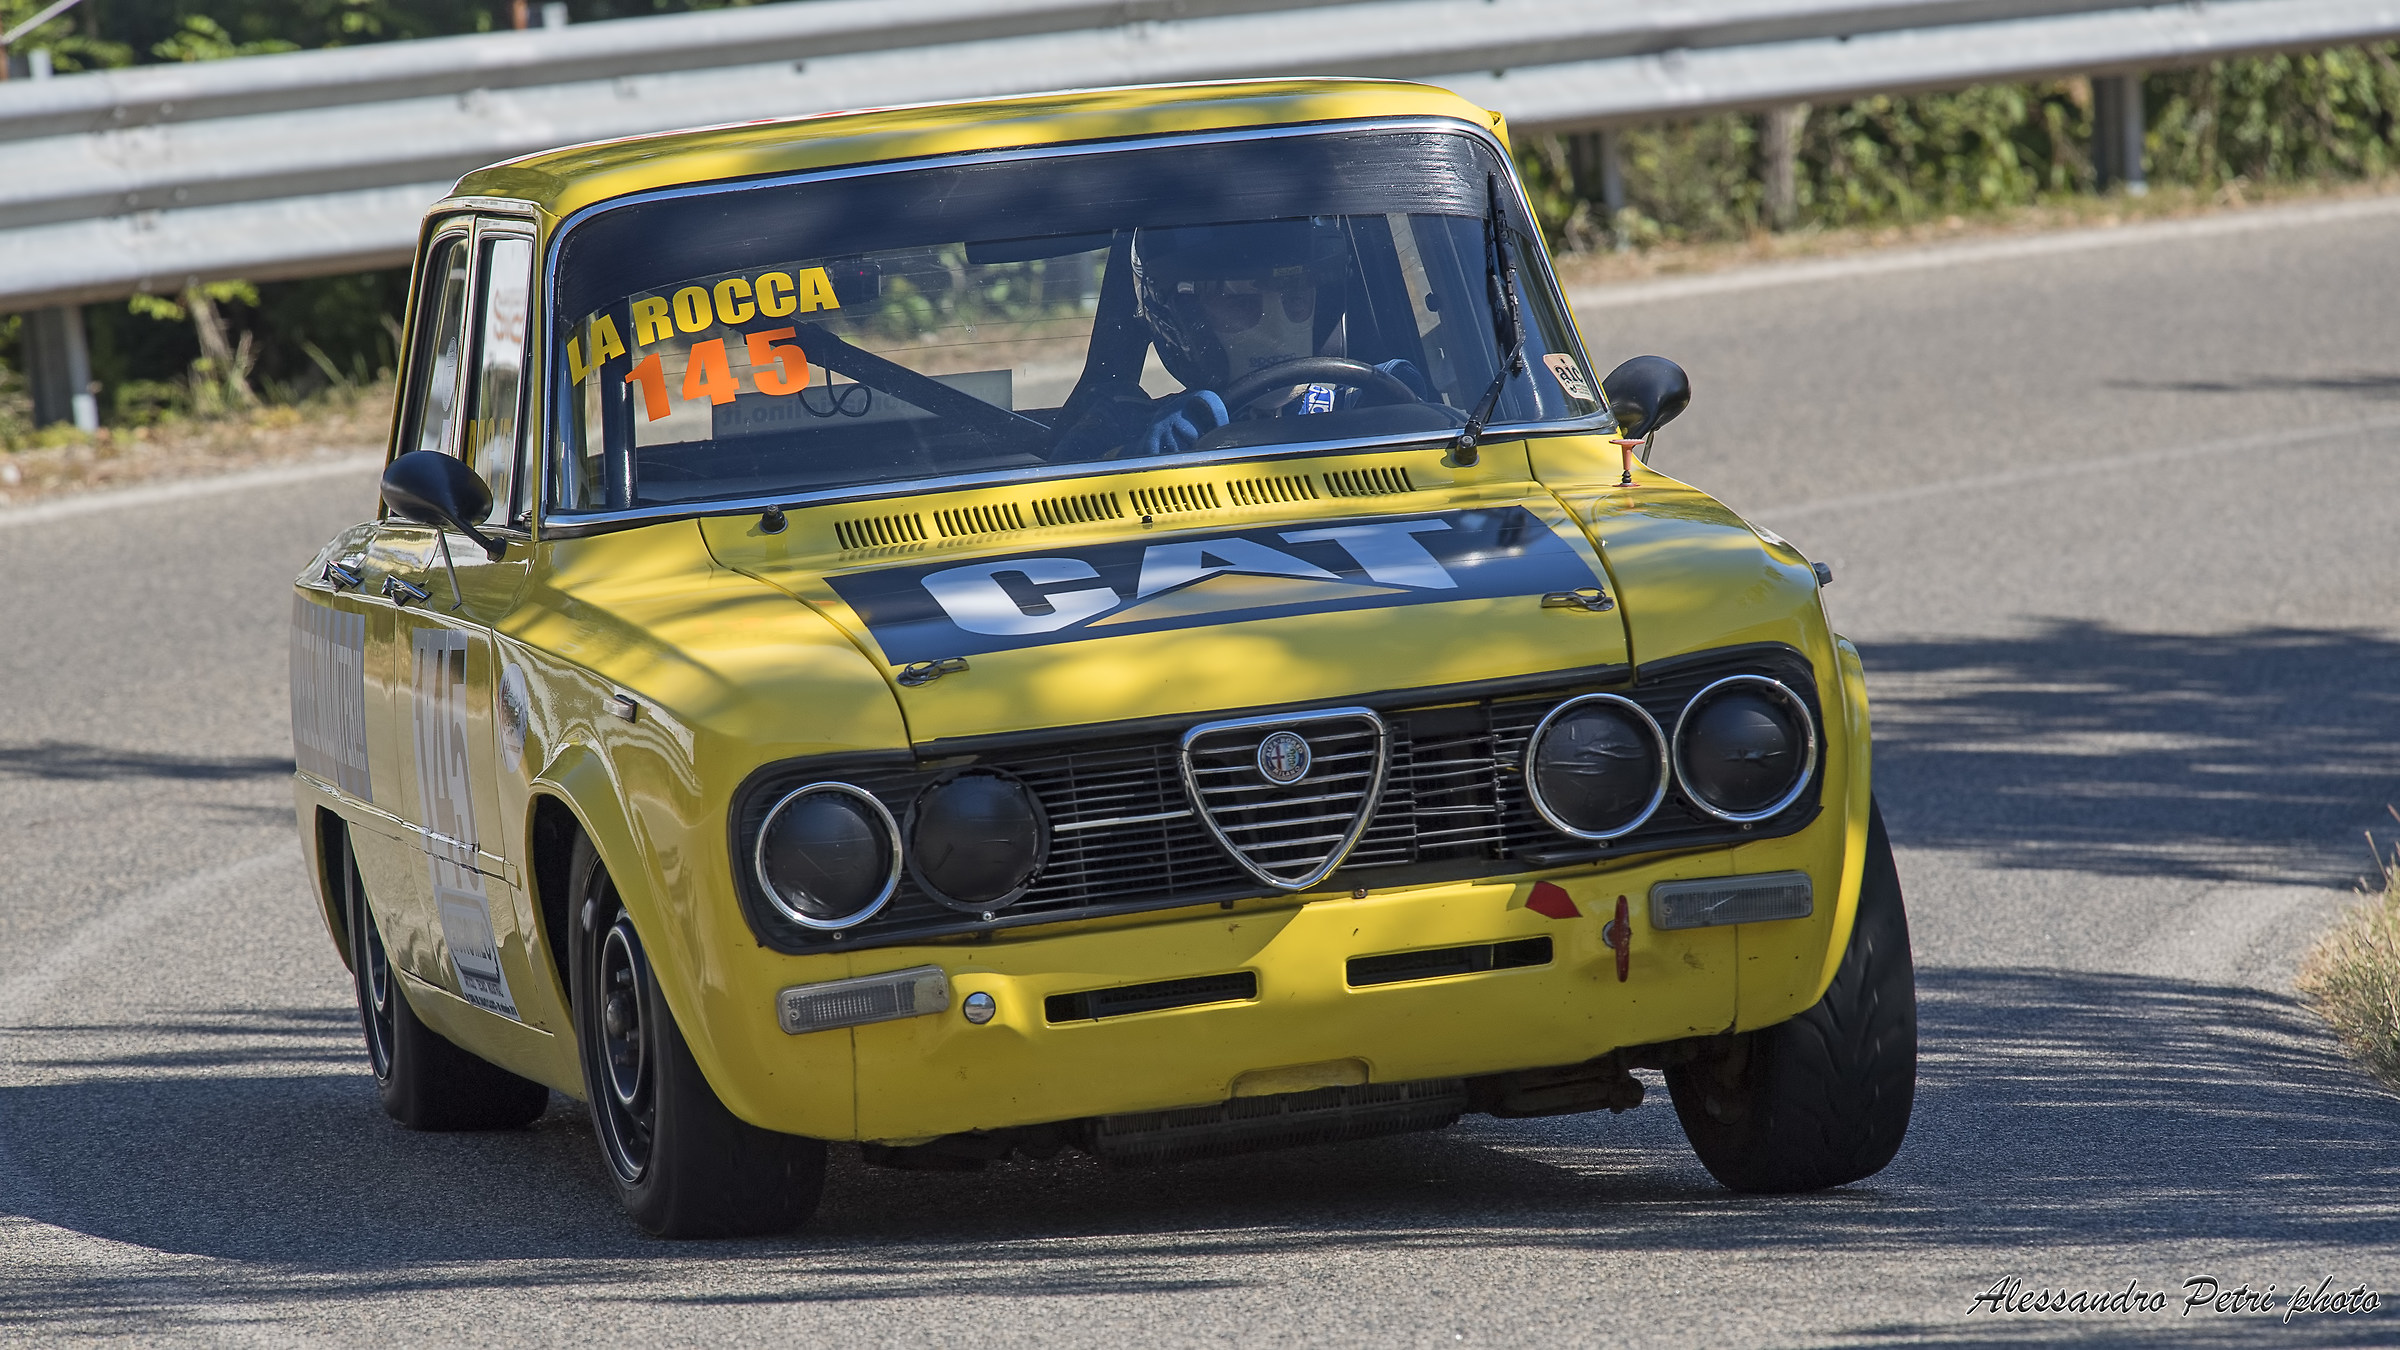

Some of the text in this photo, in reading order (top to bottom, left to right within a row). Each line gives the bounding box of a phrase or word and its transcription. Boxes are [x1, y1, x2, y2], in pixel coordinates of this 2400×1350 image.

[566, 314, 626, 386] LA
[631, 266, 840, 347] ROCCA
[624, 326, 811, 422] 145
[921, 518, 1458, 636] CAT
[415, 648, 480, 891] 145
[1273, 765, 1300, 777] MILANO
